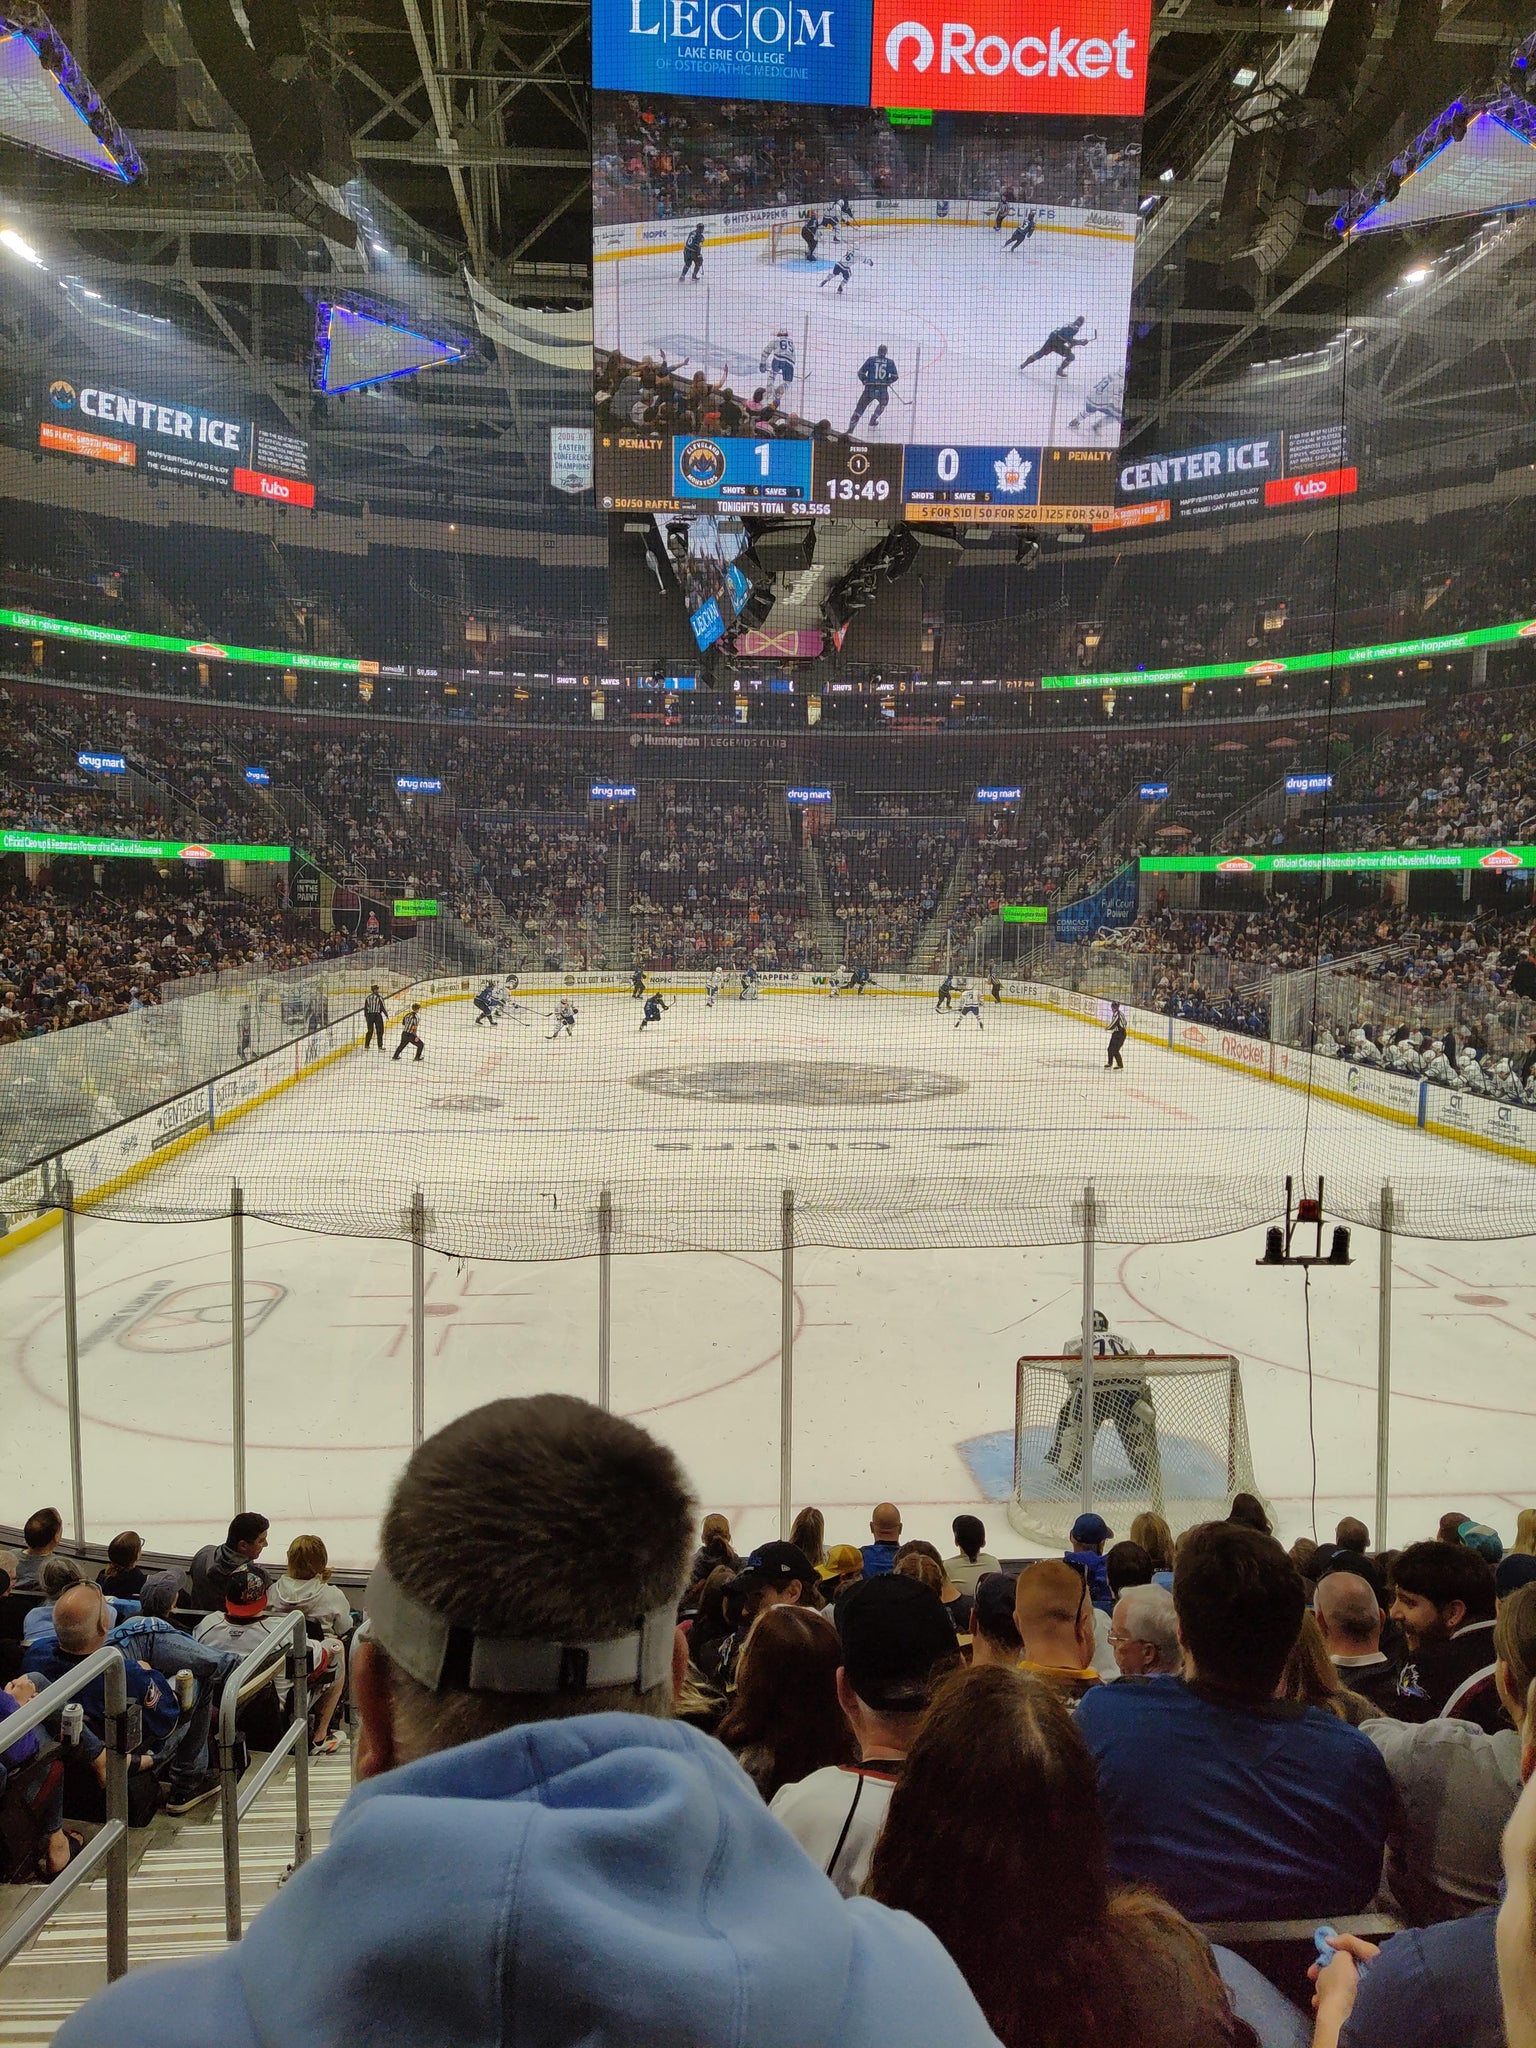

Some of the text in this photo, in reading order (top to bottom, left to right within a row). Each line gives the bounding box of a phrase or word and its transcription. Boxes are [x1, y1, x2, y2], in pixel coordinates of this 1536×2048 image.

[629, 0, 835, 48] LECOM
[678, 46, 785, 65] LAKE ERIE COLLEGE
[940, 22, 1135, 79] Rocket
[656, 58, 809, 80] OF OSTEOPATHIC MEDICINE
[874, 362, 887, 379] 16
[79, 387, 241, 452] CENTER ICE
[558, 443, 586, 452] EASTERN
[618, 438, 663, 450] PENALTY
[553, 452, 592, 461] CONFERENCE
[754, 442, 770, 476] 1
[1068, 451, 1113, 462] PENALTY
[554, 461, 591, 470] CHAMPIONS
[937, 448, 960, 482] 0
[1120, 449, 1222, 492] CENTER
[1226, 440, 1270, 474] ICE
[261, 478, 290, 498] fubo
[722, 486, 759, 495] SHOTS 6
[765, 487, 801, 496] SAVES 1
[827, 479, 890, 501] 13:49
[1293, 480, 1328, 497] fubo
[911, 491, 947, 500] SHOTS 1
[954, 492, 990, 501] SAVES 5
[614, 499, 643, 509] 50/50
[644, 500, 680, 511] RAFFLE
[717, 500, 831, 516] TONIGHT'S TOTAL $9,556
[922, 507, 928, 517] 5
[930, 507, 951, 517] FOR
[953, 507, 972, 519] $10
[979, 508, 992, 518] 50
[994, 508, 1015, 519] FOR
[1017, 508, 1038, 520] $20
[1046, 509, 1063, 519] 125
[1065, 509, 1086, 520] FOR
[1088, 509, 1110, 521] $40
[12, 615, 30, 627] Like
[292, 655, 310, 666] Like
[317, 659, 340, 669] never
[341, 662, 359, 671] eve
[582, 676, 589, 685] 6
[832, 683, 852, 691] SHOTS
[644, 734, 700, 748] Huntington
[710, 737, 758, 748] LEGENDS
[78, 755, 126, 770] drug mart
[397, 777, 442, 790] drug mart
[1286, 777, 1308, 790] drug
[591, 785, 637, 798] drug mart
[787, 789, 832, 802] drug mart
[977, 788, 1022, 801] drug mart
[1273, 857, 1298, 868] Official
[305, 884, 319, 893] THE
[1106, 908, 1130, 918] Power
[1009, 985, 1037, 996] CLIFFS
[1231, 1037, 1264, 1065] Rocket
